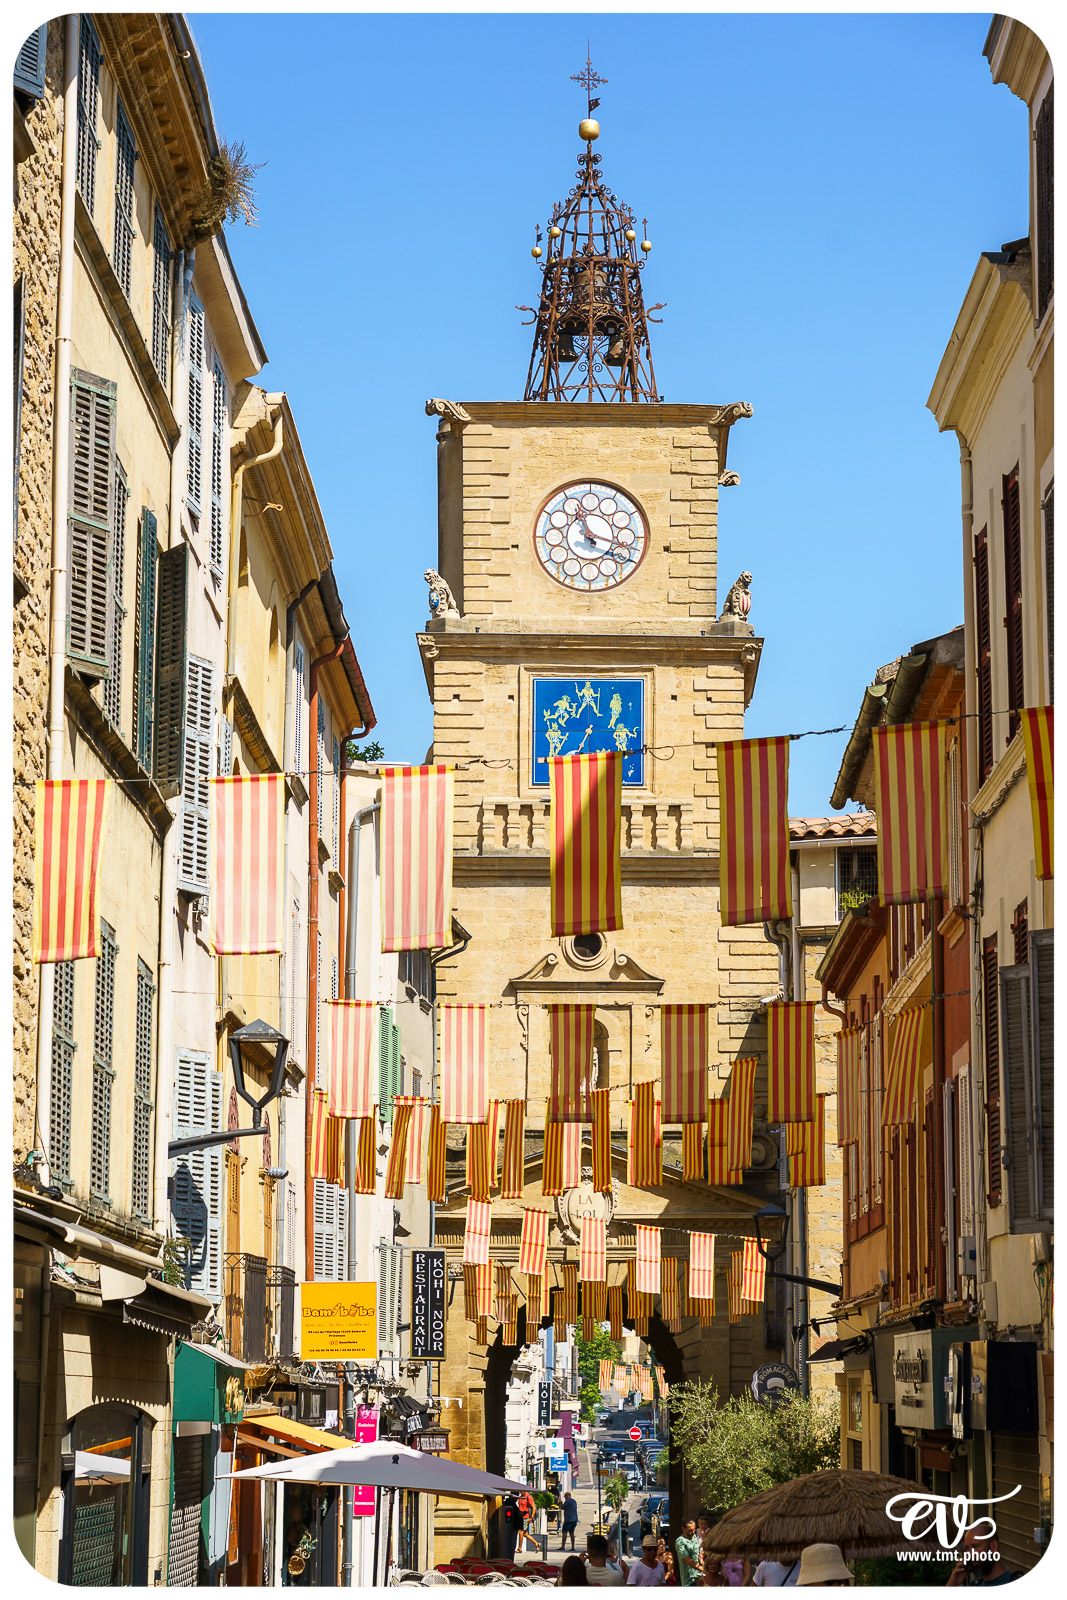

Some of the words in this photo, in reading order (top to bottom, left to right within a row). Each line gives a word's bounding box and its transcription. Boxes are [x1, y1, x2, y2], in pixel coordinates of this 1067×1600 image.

[578, 1194, 593, 1205] LA
[576, 1209, 596, 1219] LOI
[414, 1253, 426, 1356] RESTAURANT
[757, 1366, 793, 1384] FROMAGERIE
